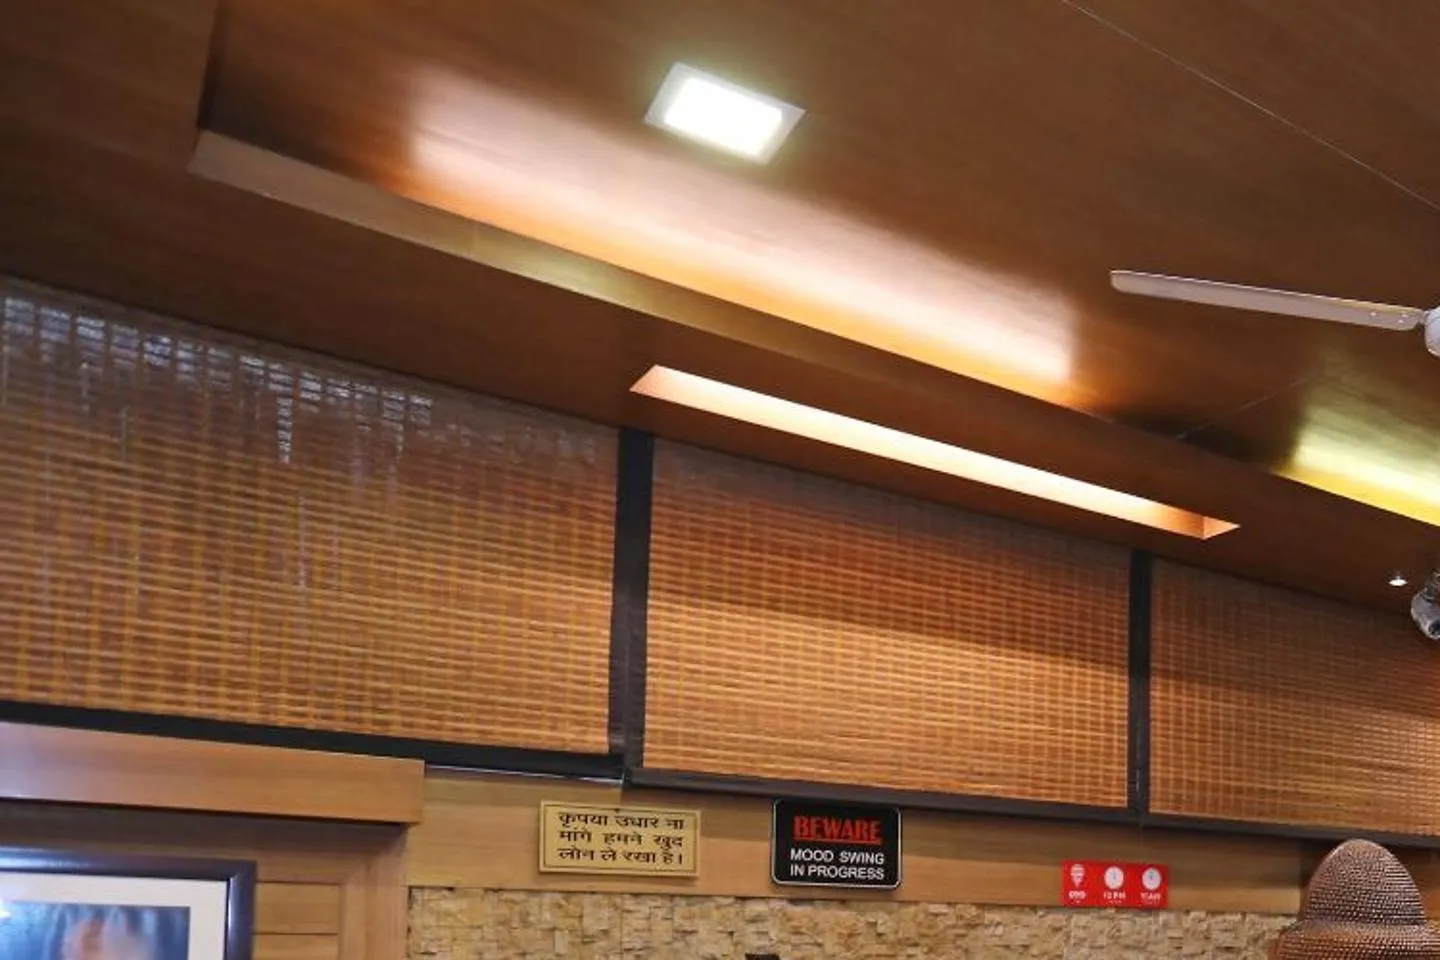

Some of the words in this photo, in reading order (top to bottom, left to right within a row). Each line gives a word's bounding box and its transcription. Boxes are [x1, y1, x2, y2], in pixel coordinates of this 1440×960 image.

[558, 811, 608, 828] कृपया
[614, 815, 659, 829] उधार
[665, 818, 685, 830] ना
[792, 815, 881, 842] BEWARE
[602, 831, 642, 846] हमने
[652, 834, 683, 851] खुद
[556, 845, 595, 861] लोन
[600, 846, 616, 861] ले
[622, 851, 656, 864] रखा
[790, 847, 834, 862] MOOD
[838, 850, 885, 865] SWING
[790, 864, 805, 877] IN
[807, 865, 885, 880] PROGRESS
